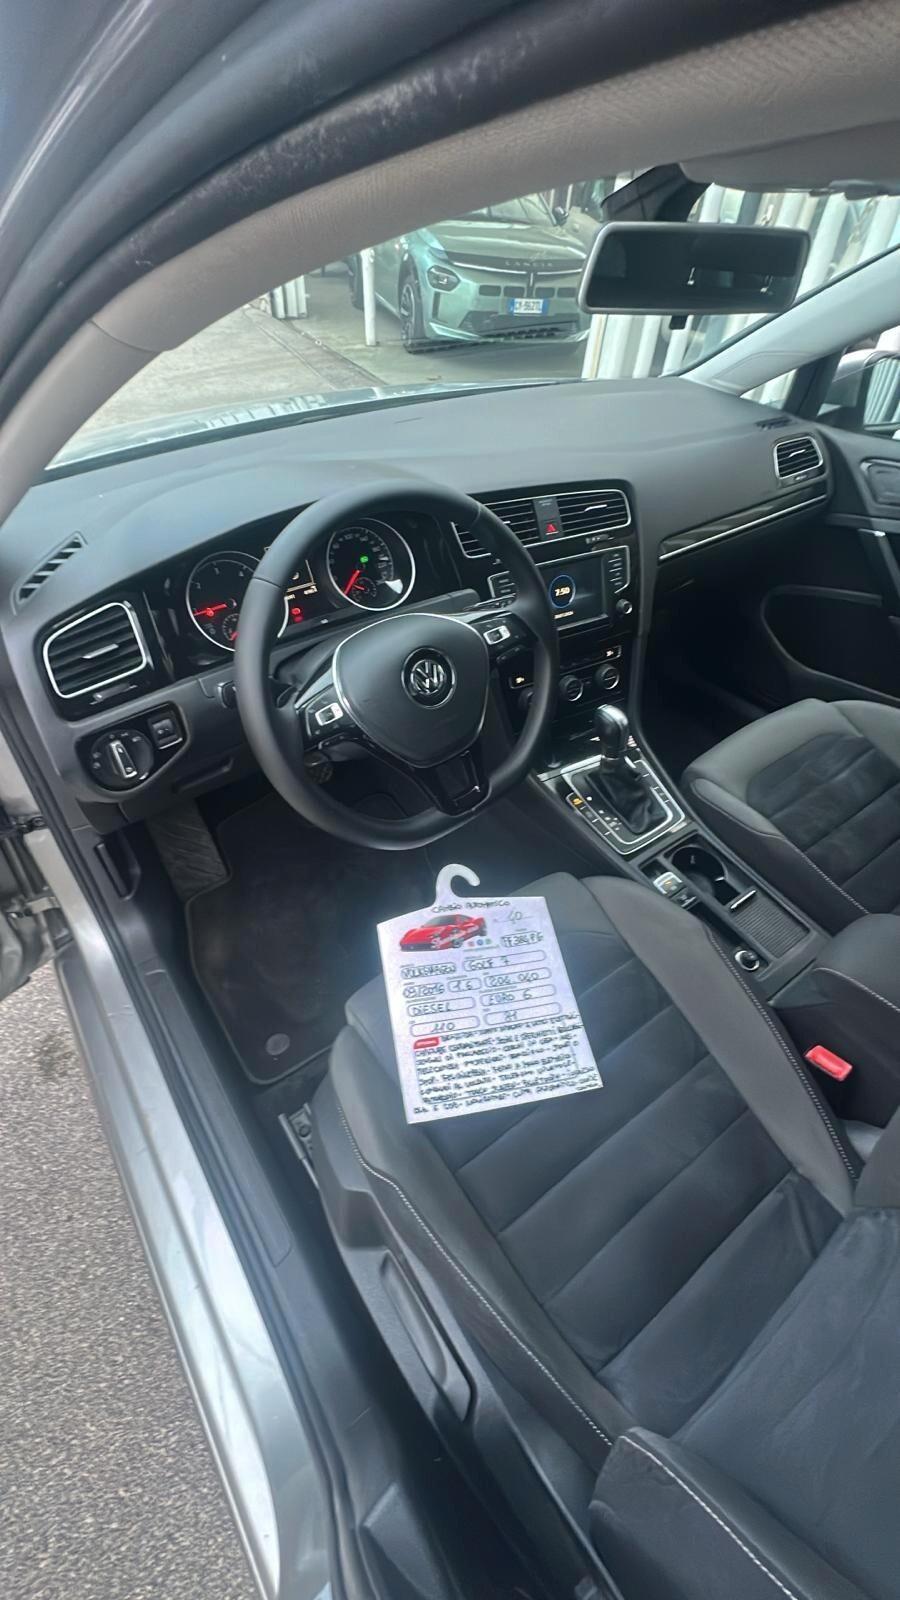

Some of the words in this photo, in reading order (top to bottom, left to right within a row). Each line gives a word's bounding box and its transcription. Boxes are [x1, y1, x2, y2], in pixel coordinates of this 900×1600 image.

[470, 959, 494, 971] GOLF
[523, 988, 533, 999] 6
[412, 1003, 451, 1015] DIESEL
